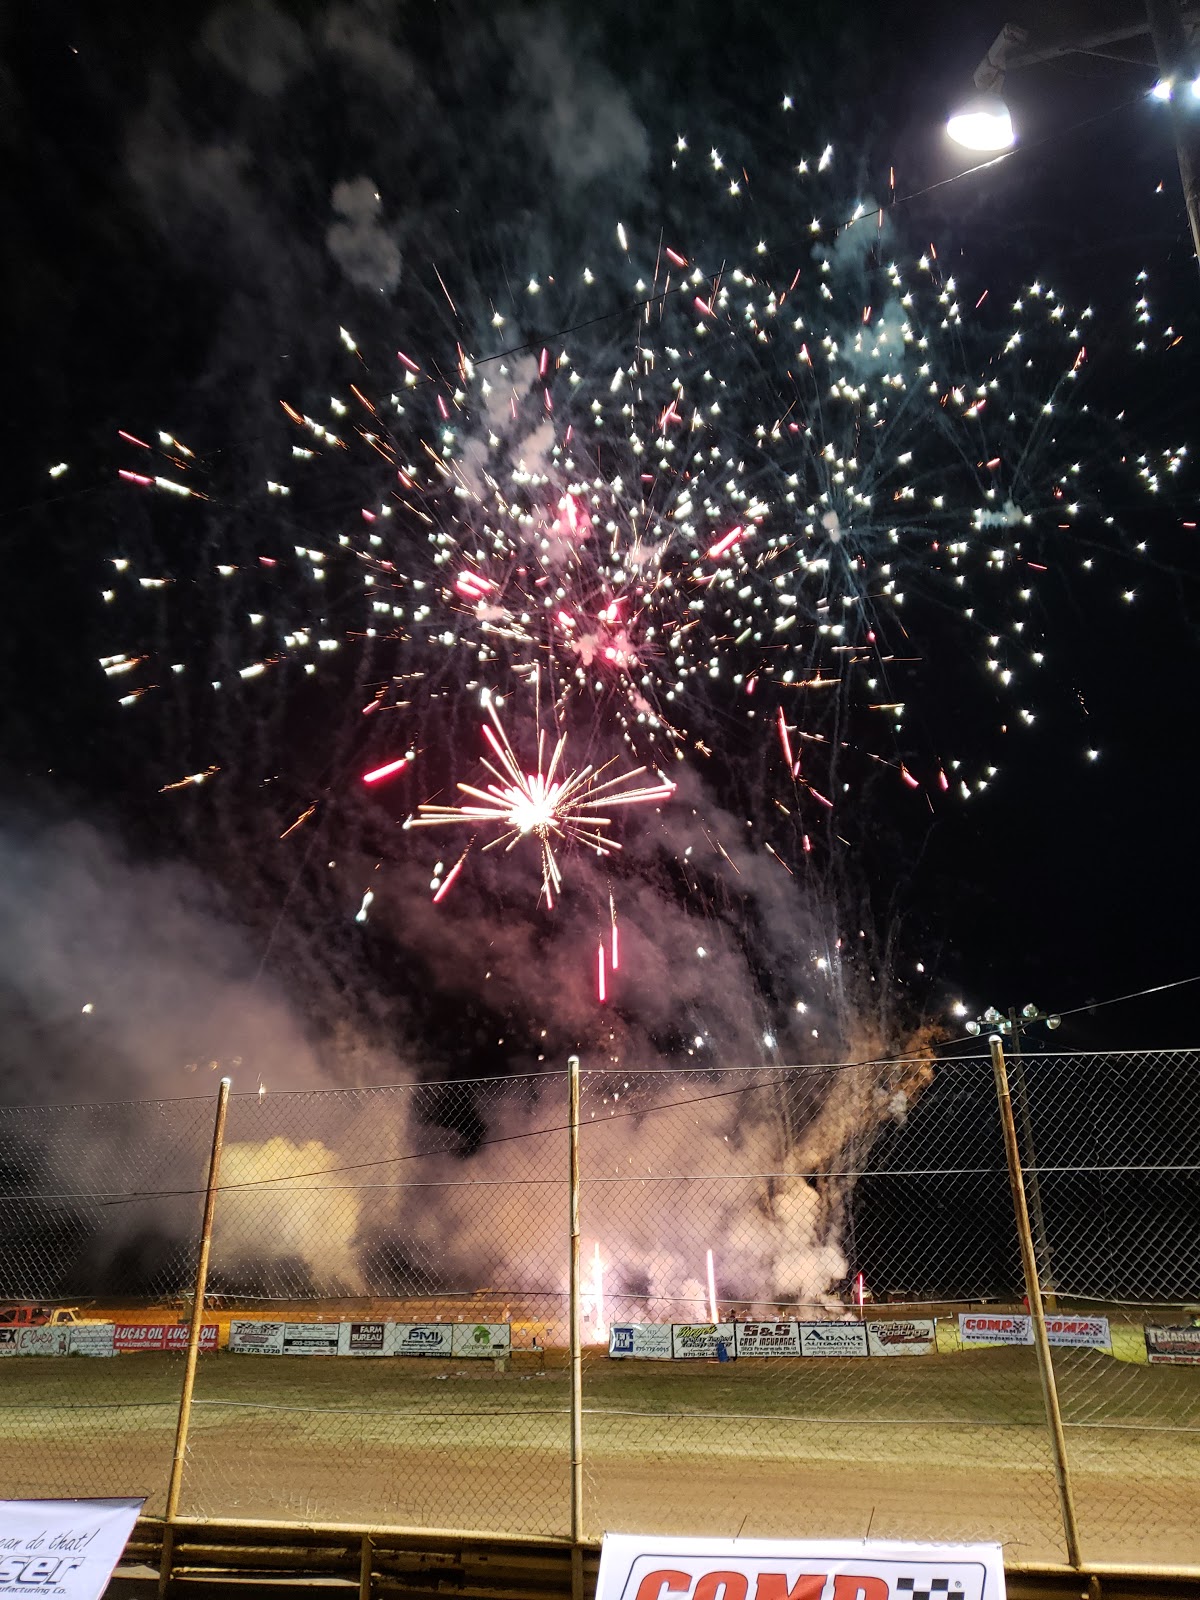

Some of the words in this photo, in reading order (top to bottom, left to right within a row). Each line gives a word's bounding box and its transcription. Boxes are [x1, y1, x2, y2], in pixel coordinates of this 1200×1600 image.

[966, 1319, 1013, 1330] COMP
[1045, 1321, 1089, 1333] COMP
[115, 1328, 147, 1339] LUCAS
[148, 1328, 163, 1339] OIL
[167, 1328, 190, 1339] LUC
[201, 1328, 216, 1339] OIL
[409, 1331, 439, 1339] PMI
[804, 1329, 864, 1341] ADAMS
[740, 1338, 757, 1346] CROP
[759, 1337, 797, 1346] INSURANCE
[26, 1530, 47, 1550] do
[49, 1528, 100, 1553] that!
[0, 1555, 86, 1585] ser
[635, 1570, 889, 1600] COMP
